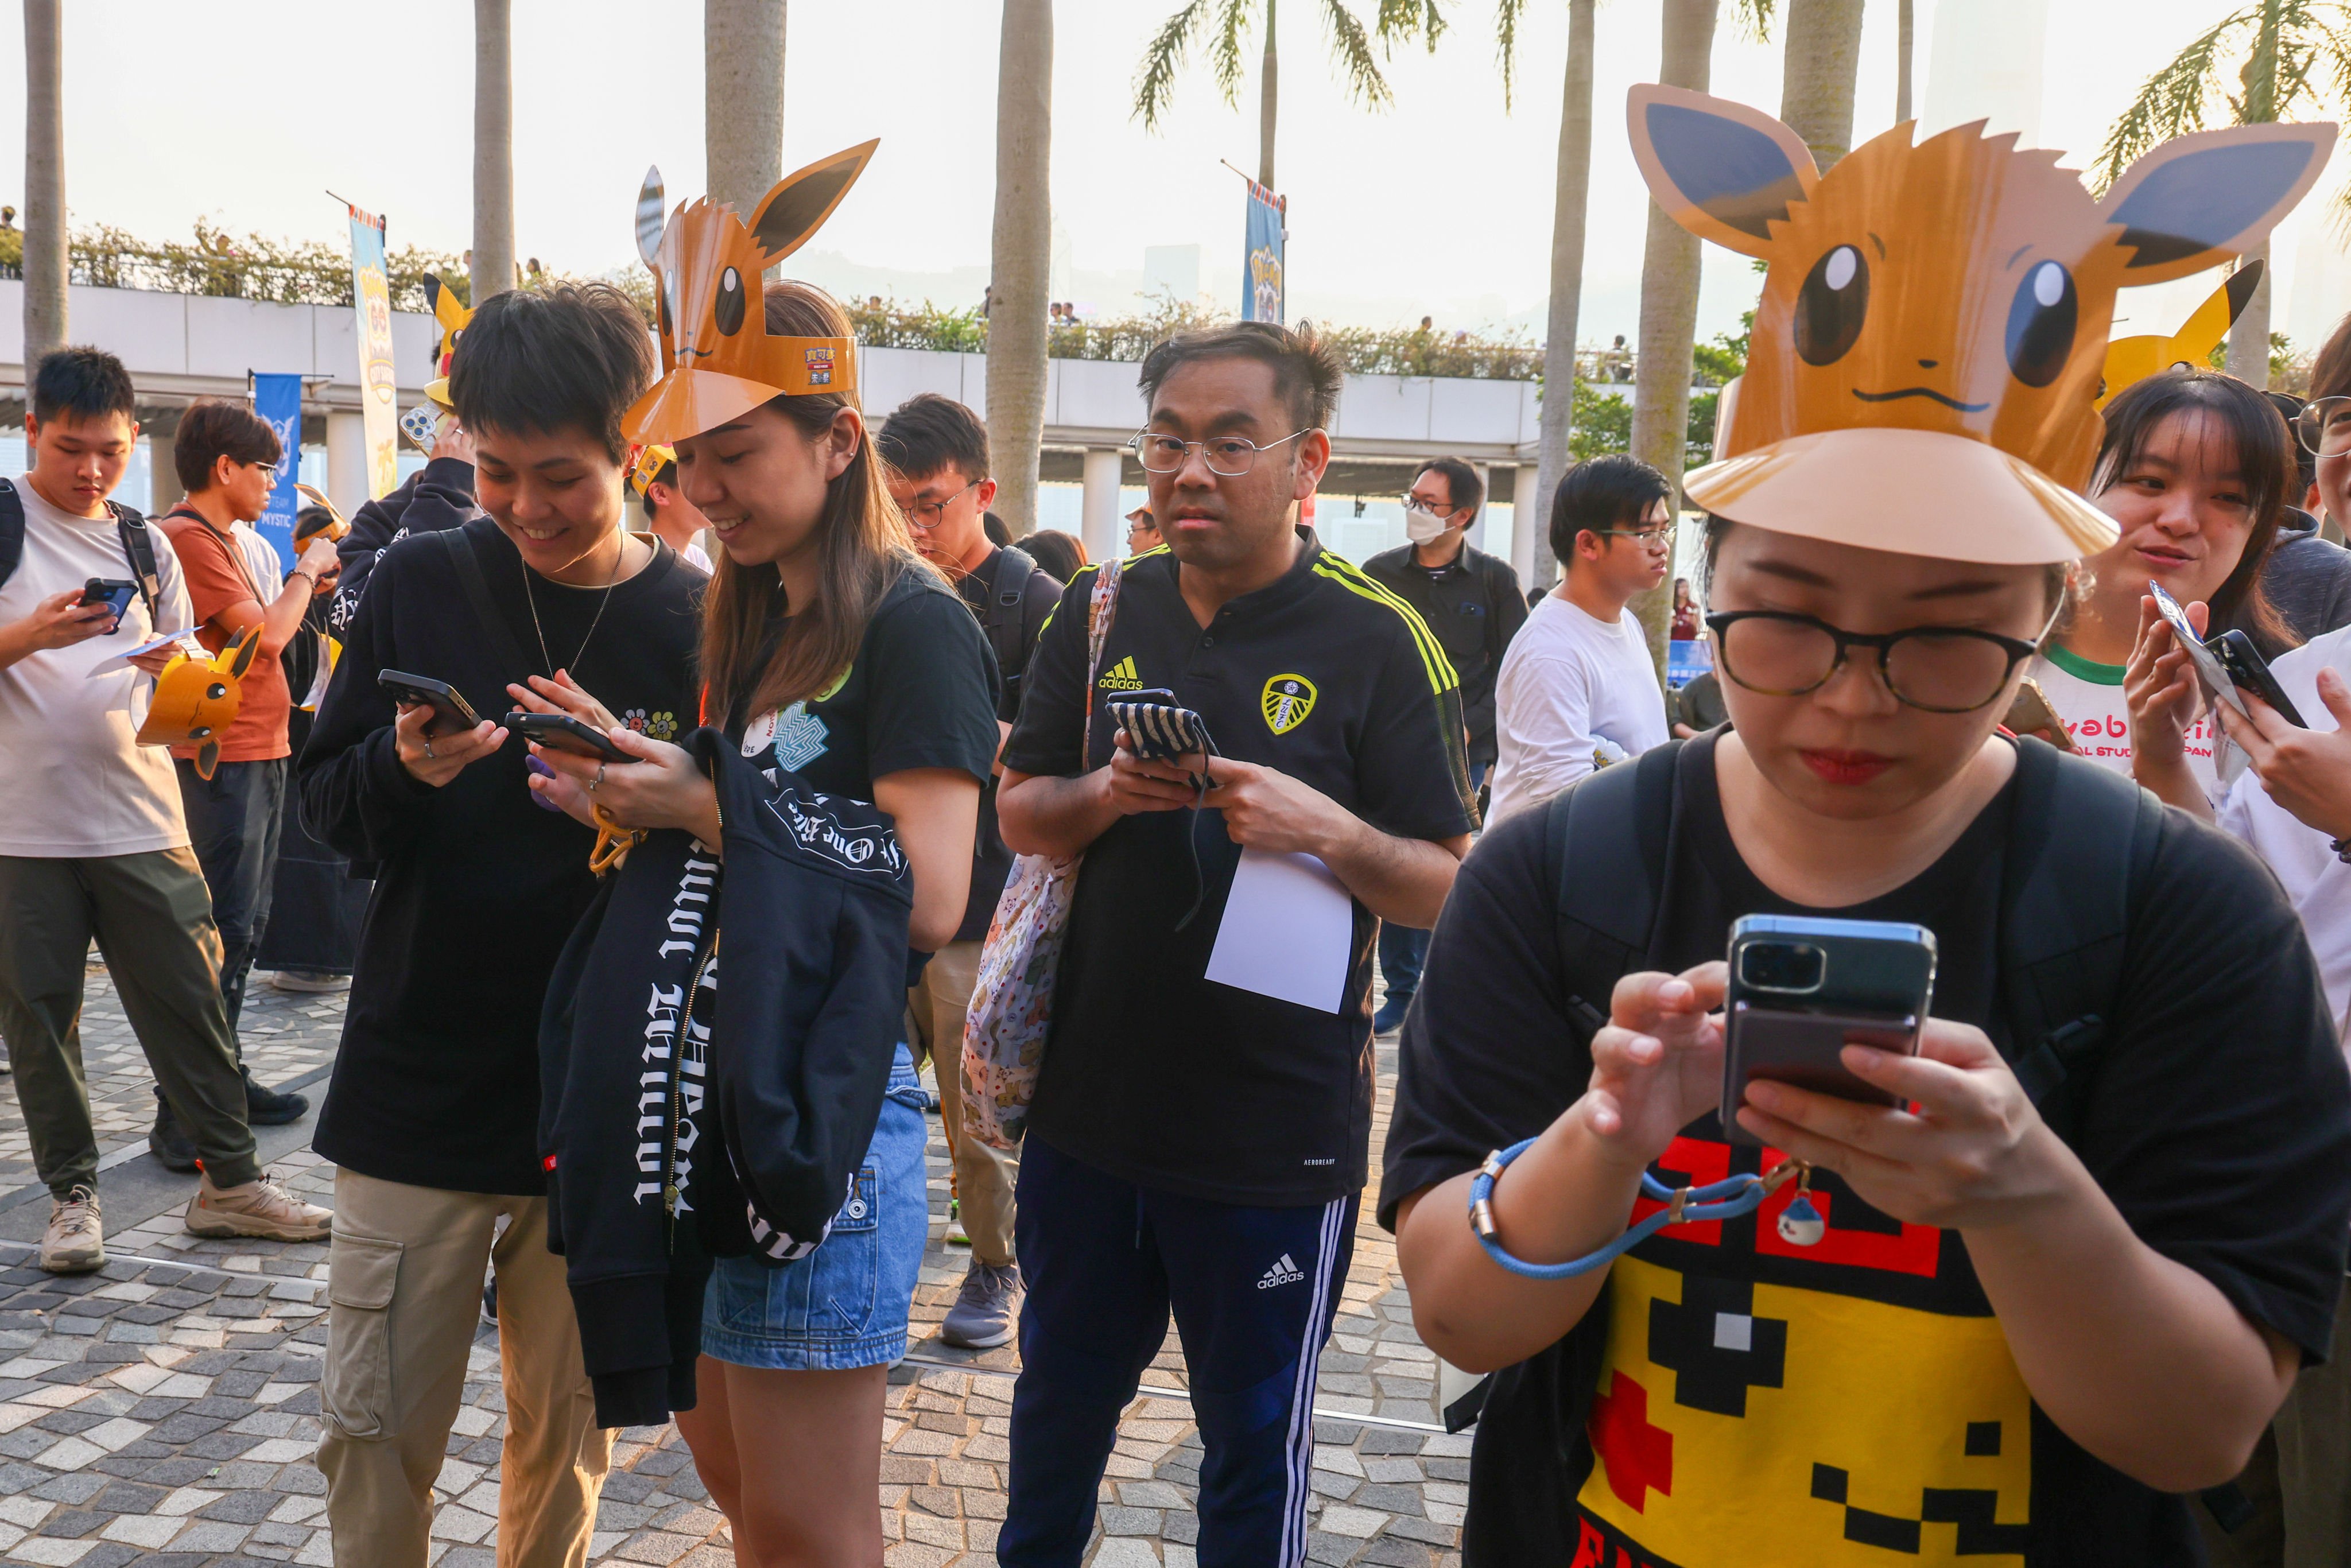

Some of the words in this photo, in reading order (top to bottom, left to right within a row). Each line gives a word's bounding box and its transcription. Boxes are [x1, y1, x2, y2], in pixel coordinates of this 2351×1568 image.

[271, 495, 290, 509] TEAM
[261, 512, 292, 528] MYSTIC
[1099, 676, 1143, 690] adidas
[1275, 698, 1292, 728] LUFC
[823, 825, 875, 864] One
[1257, 1271, 1305, 1290] adidas
